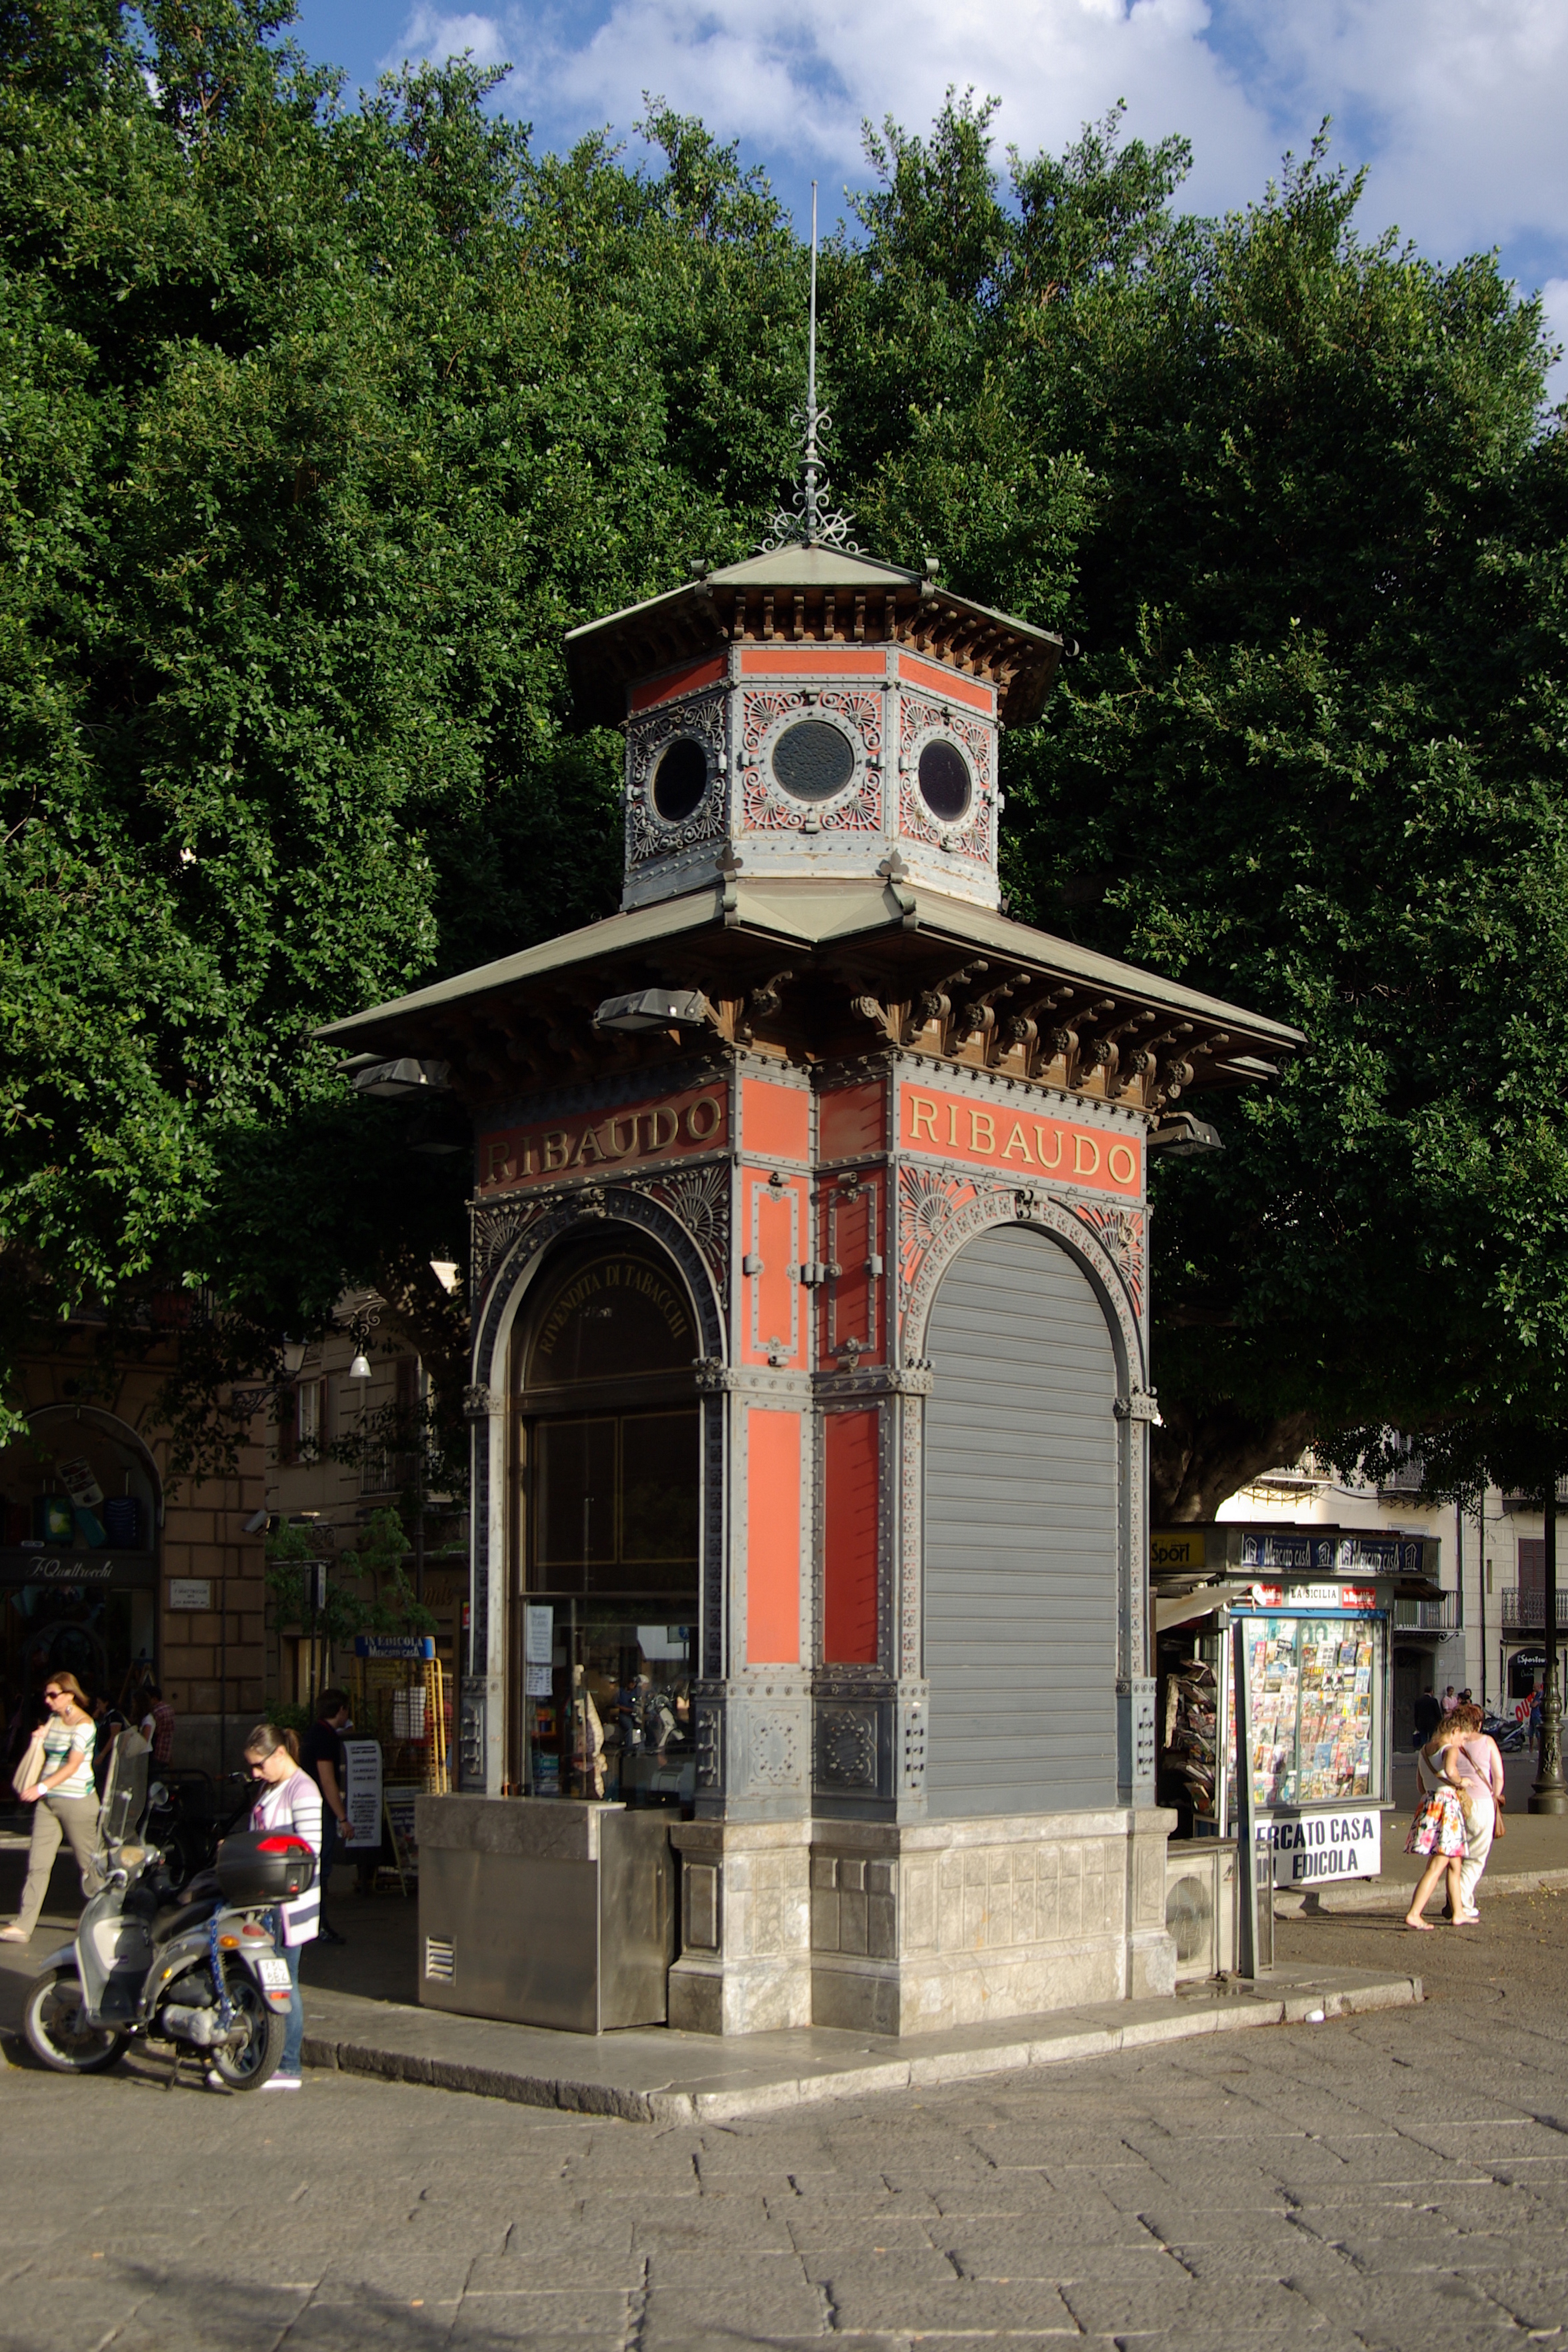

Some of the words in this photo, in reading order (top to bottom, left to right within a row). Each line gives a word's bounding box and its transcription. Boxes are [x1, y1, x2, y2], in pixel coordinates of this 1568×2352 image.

[484, 1096, 722, 1184] RIBAUDO
[909, 1095, 1136, 1184] RIBAUDO
[539, 1272, 601, 1355] RIVENDITA
[605, 1265, 621, 1288] DI
[625, 1265, 688, 1339] TABACCHI
[1151, 1543, 1190, 1564] Sport
[1291, 1589, 1302, 1599] LA
[1305, 1589, 1337, 1599] SICILIA
[1257, 1821, 1325, 1851] ERCATO
[1330, 1817, 1373, 1843] CASA
[1293, 1848, 1358, 1880] EDICOLA
